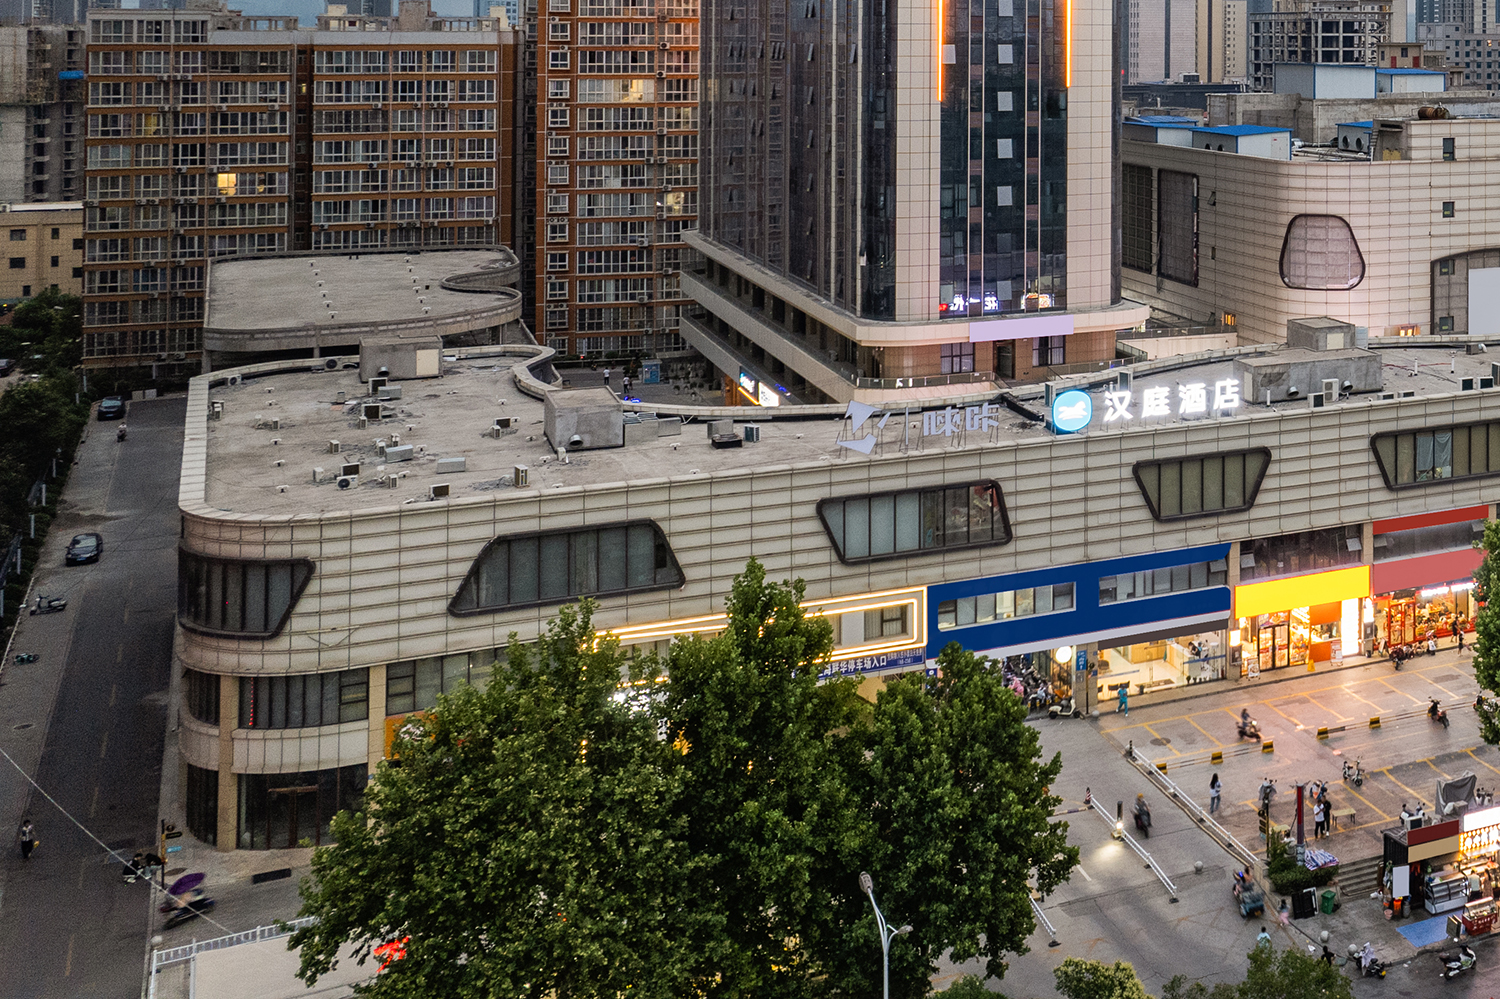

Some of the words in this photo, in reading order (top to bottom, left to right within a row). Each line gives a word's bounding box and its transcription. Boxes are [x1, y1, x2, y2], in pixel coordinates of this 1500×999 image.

[1104, 379, 1241, 421] 汉庭酒店
[818, 655, 887, 677] 海联华停车场入口
